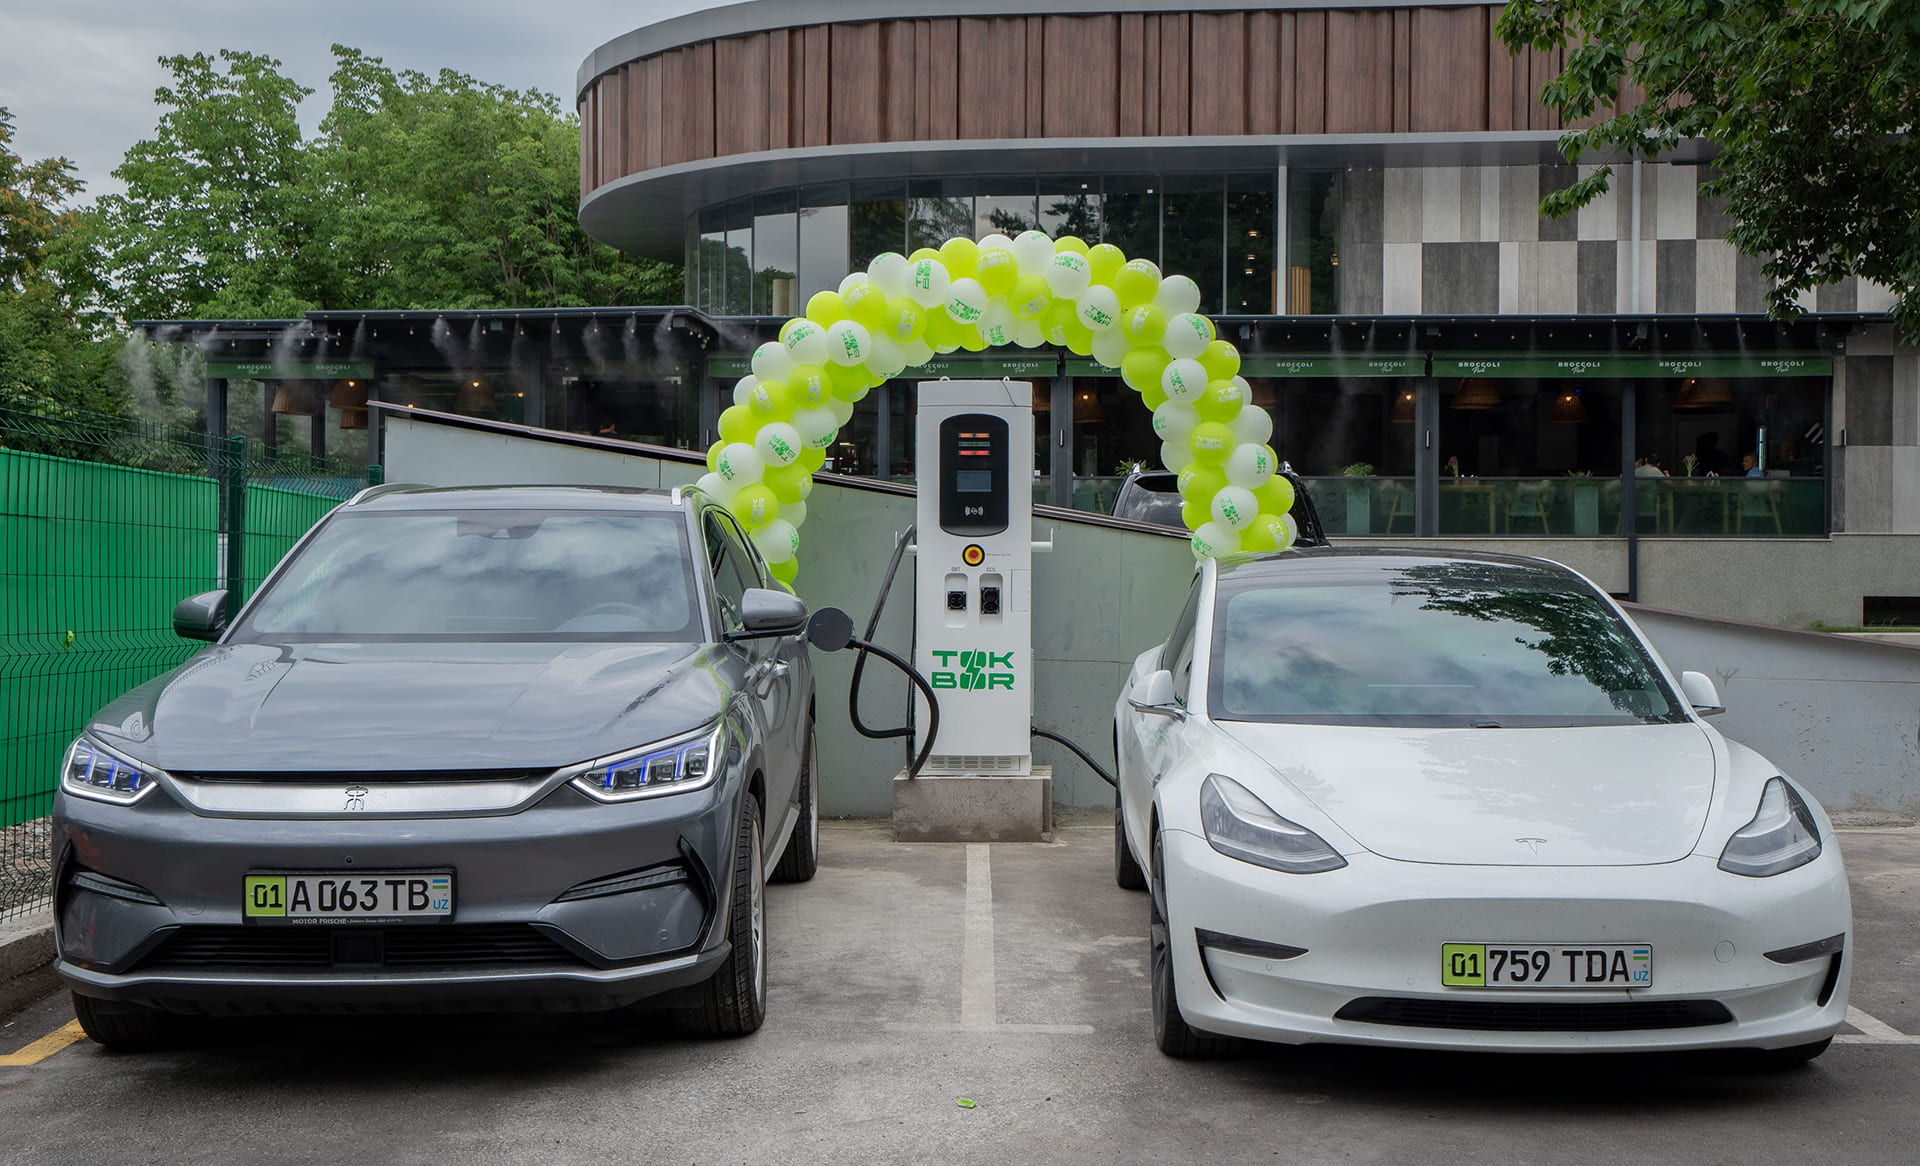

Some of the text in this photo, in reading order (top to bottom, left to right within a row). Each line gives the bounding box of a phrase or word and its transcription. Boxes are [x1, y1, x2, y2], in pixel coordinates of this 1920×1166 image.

[932, 649, 1015, 668] TOK
[931, 671, 1015, 691] BOR
[254, 879, 429, 912] 01 A 063 TB
[433, 899, 449, 910] UZ
[1451, 949, 1630, 982] 01 759 TDA
[1633, 970, 1649, 982] UZ
